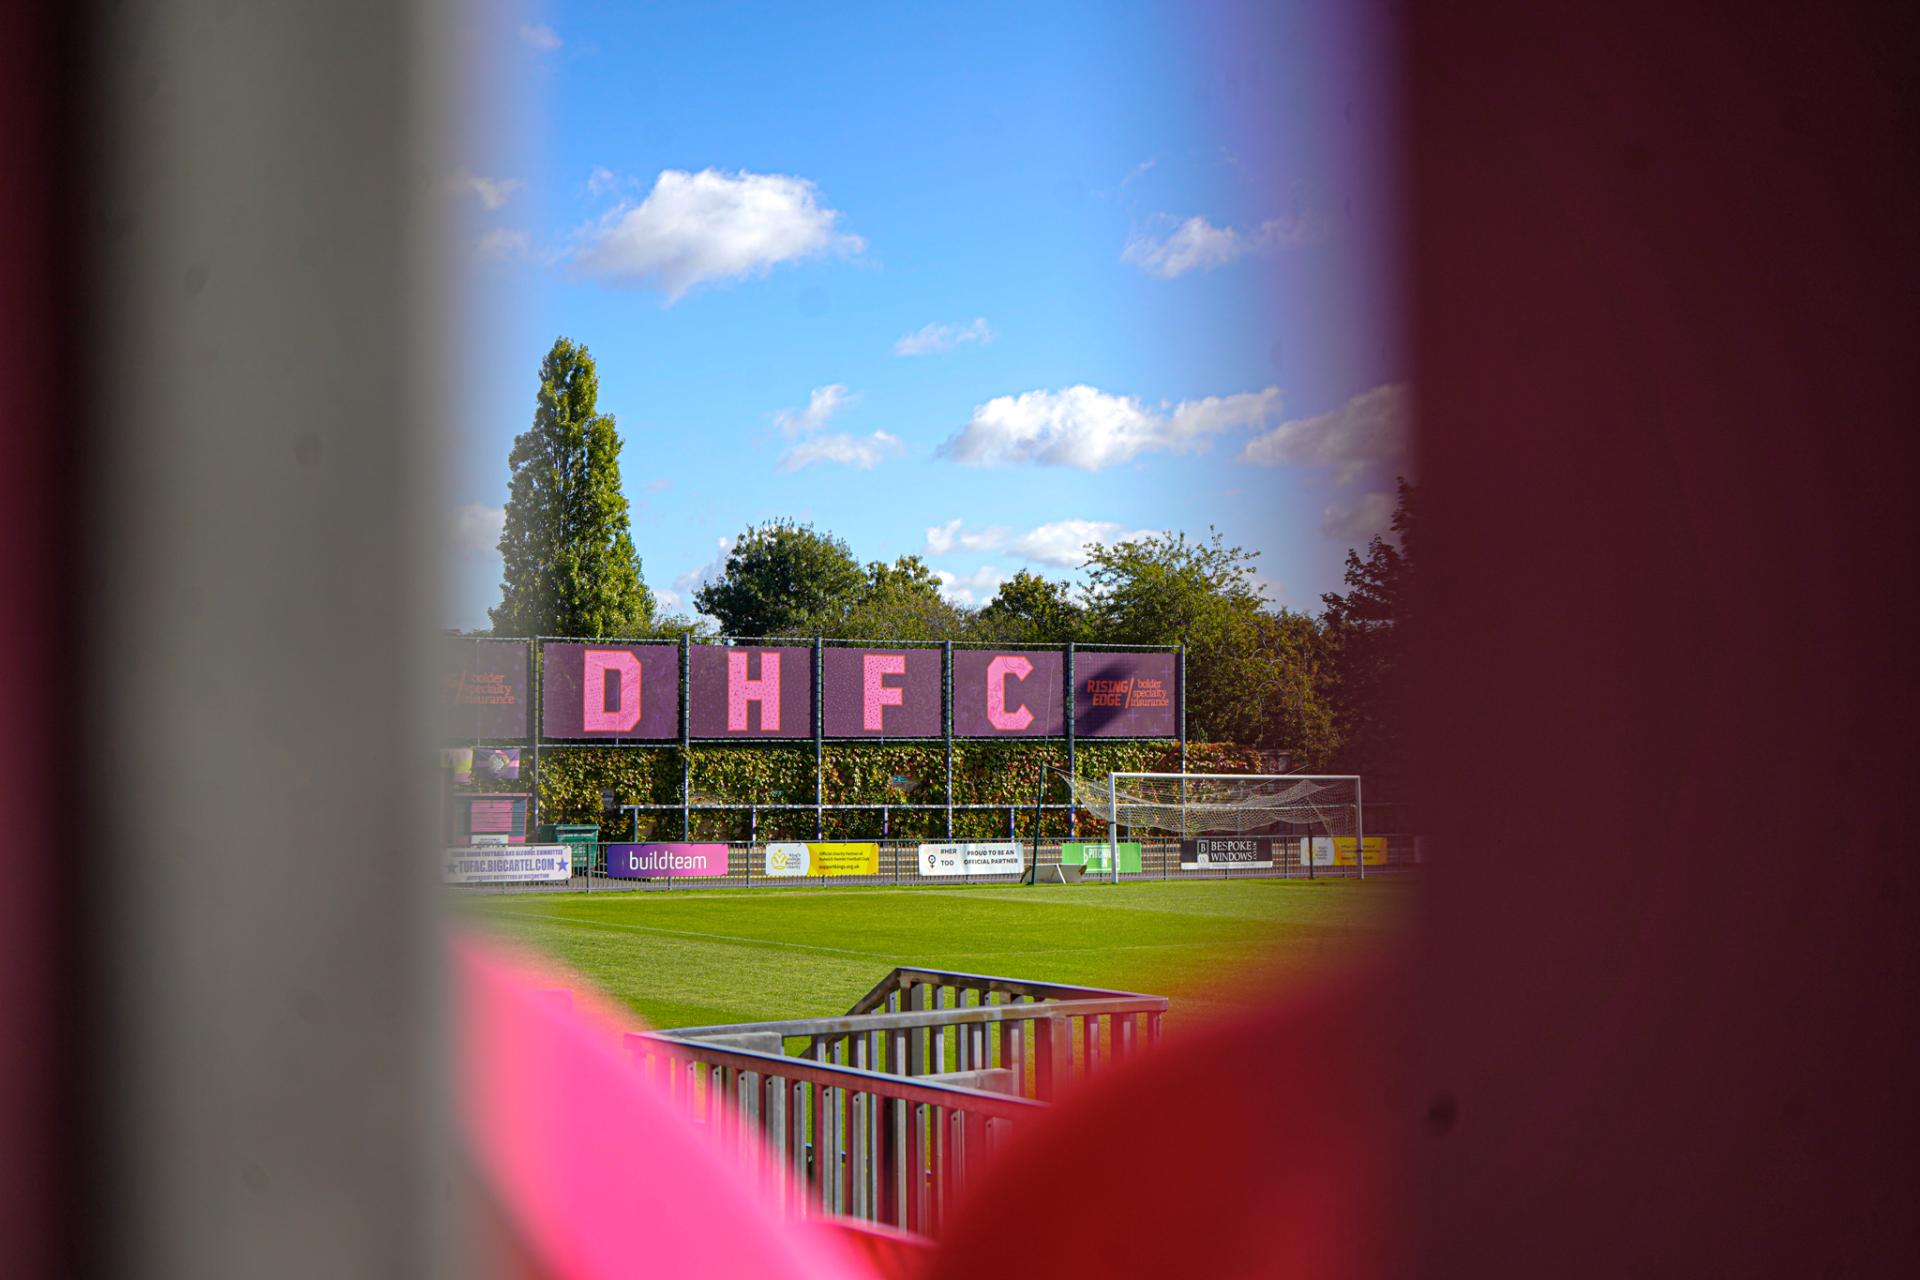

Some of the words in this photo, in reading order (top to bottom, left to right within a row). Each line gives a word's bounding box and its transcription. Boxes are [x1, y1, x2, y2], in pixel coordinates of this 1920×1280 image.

[583, 650, 642, 732] D
[727, 652, 780, 732] H
[862, 654, 906, 731] F
[986, 655, 1034, 732] C
[1087, 679, 1128, 693] RISING
[1092, 693, 1121, 706] EDGE
[1211, 841, 1252, 851] BESPOKE
[629, 850, 707, 870] buildteam
[1211, 852, 1253, 862] WINDOWS
[458, 858, 555, 873] TUFAC.BIGCARTEL.COM
